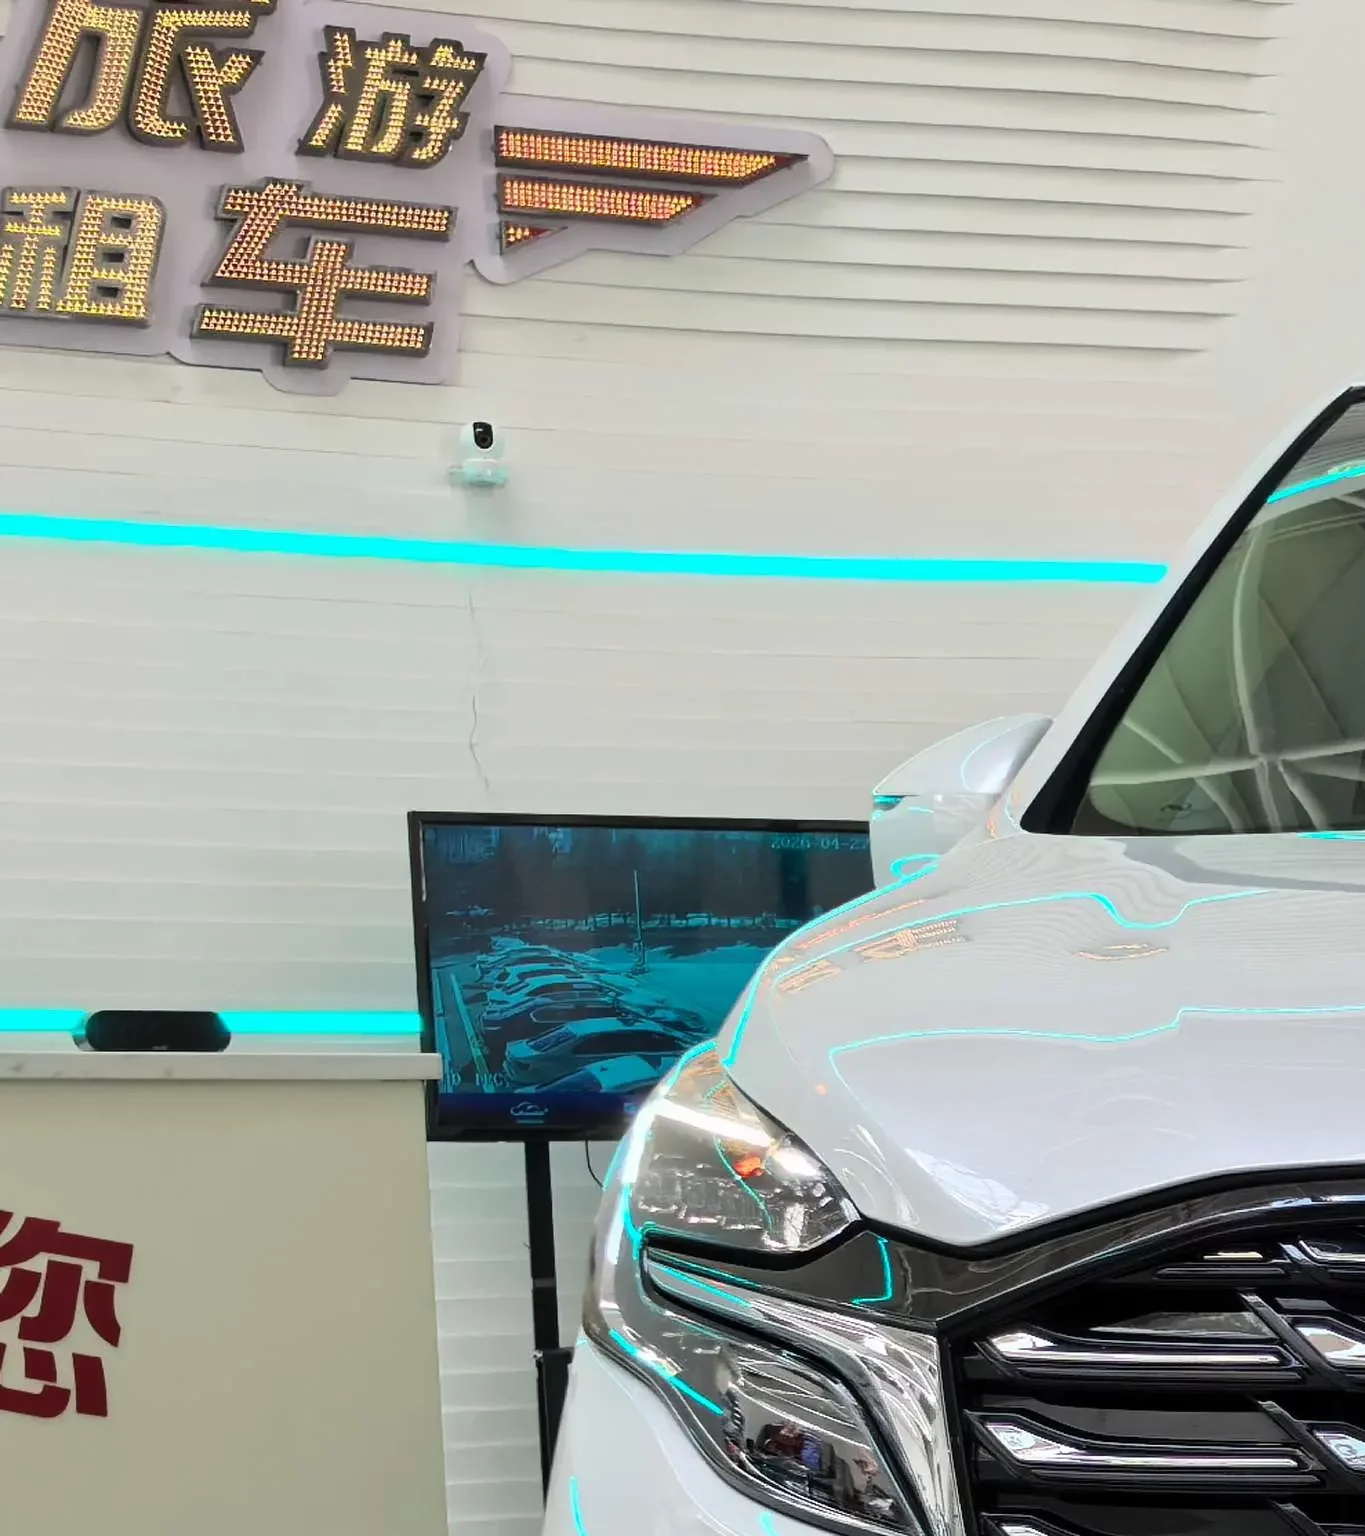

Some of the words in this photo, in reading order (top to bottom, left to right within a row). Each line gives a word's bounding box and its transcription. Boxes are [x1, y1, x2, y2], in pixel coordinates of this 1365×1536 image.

[6, 0, 488, 168] 旅游
[0, 178, 459, 370] 租车
[0, 1209, 135, 1418] 您
